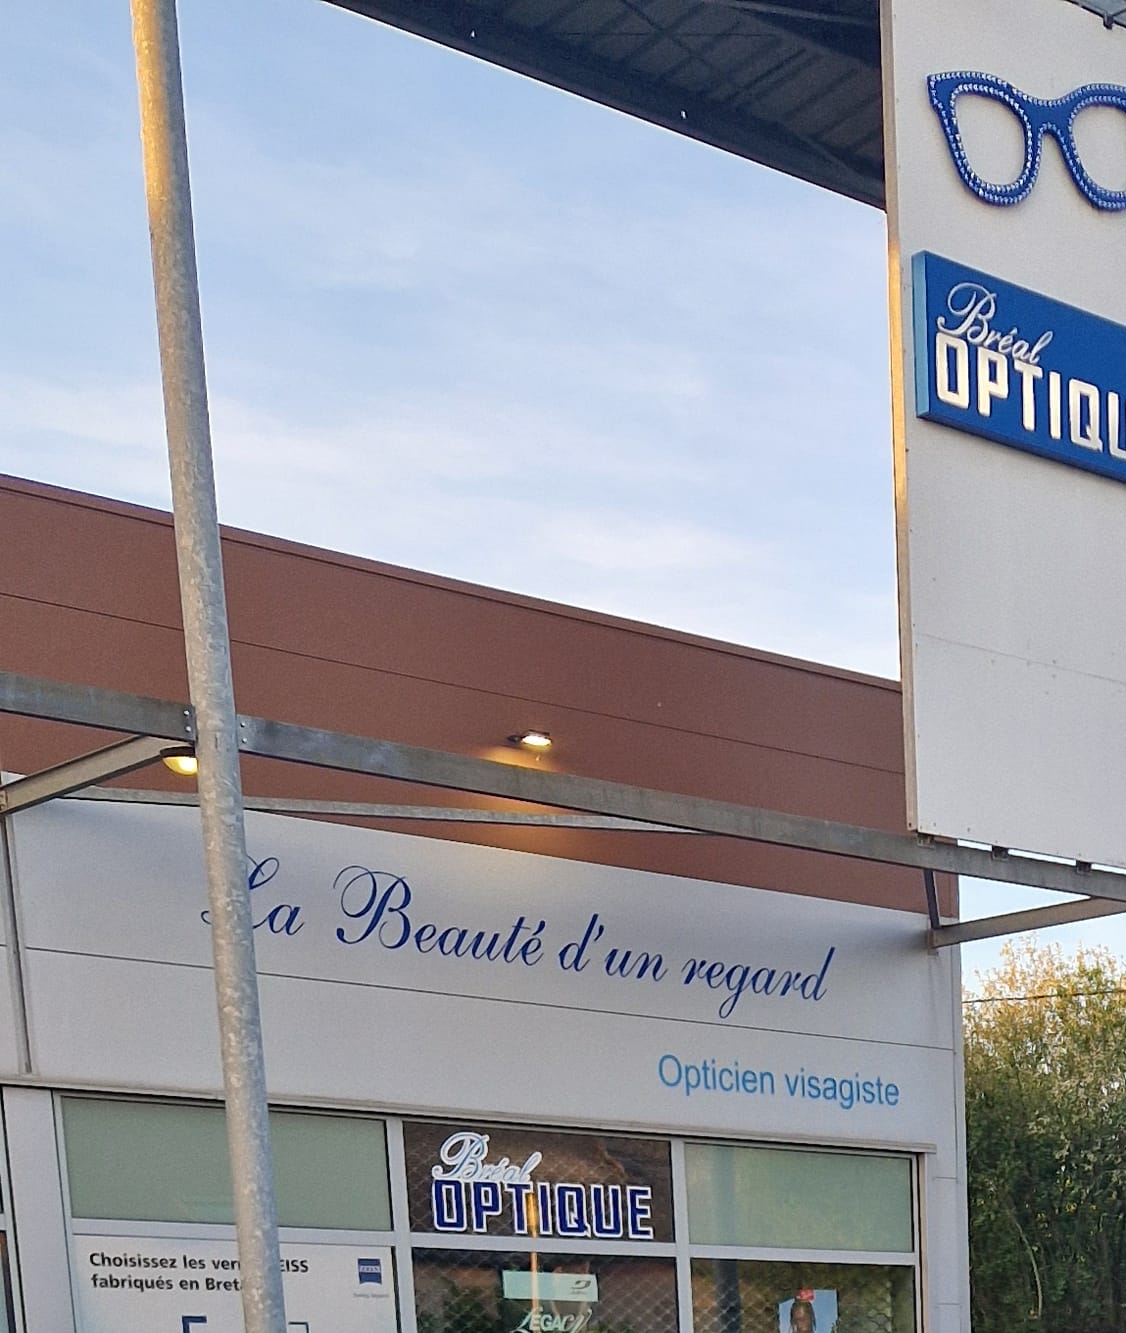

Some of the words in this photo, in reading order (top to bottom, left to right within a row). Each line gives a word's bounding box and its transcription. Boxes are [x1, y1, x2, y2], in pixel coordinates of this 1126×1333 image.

[937, 282, 1053, 364] Bréal
[333, 865, 546, 966] Beauté
[558, 913, 669, 981] d'un
[681, 946, 835, 1019] regard
[658, 1054, 775, 1096] Opticien
[784, 1068, 900, 1110] visagiste
[432, 1131, 542, 1182] Bréal
[432, 1178, 654, 1239] OPTIQUE
[89, 1252, 177, 1269] Choisissez
[183, 1255, 206, 1270] les
[279, 1258, 309, 1273] EISS
[91, 1274, 173, 1292] fabriqués
[179, 1277, 199, 1290] en
